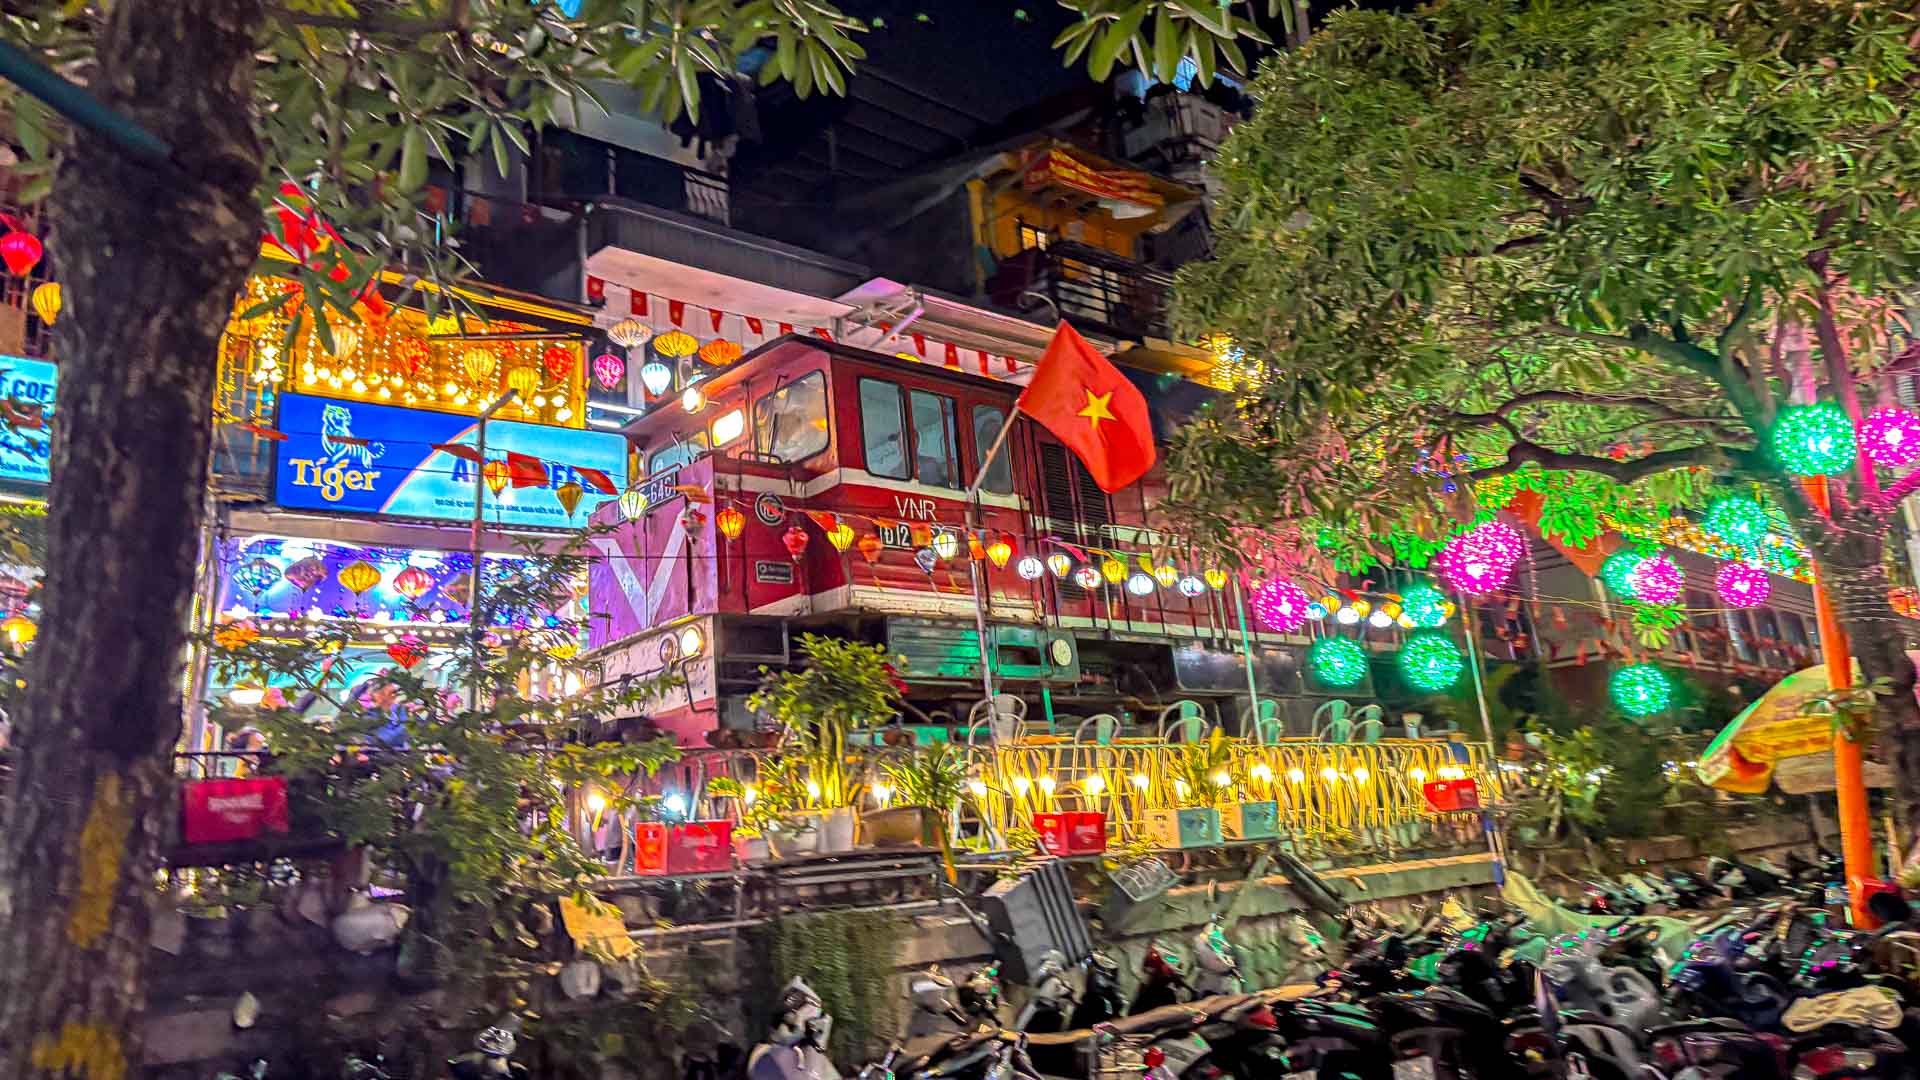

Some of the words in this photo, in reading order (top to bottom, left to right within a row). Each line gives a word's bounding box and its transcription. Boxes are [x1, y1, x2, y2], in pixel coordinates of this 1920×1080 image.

[12, 379, 55, 401] COF
[288, 457, 381, 501] Tiger
[894, 495, 937, 521] VNR
